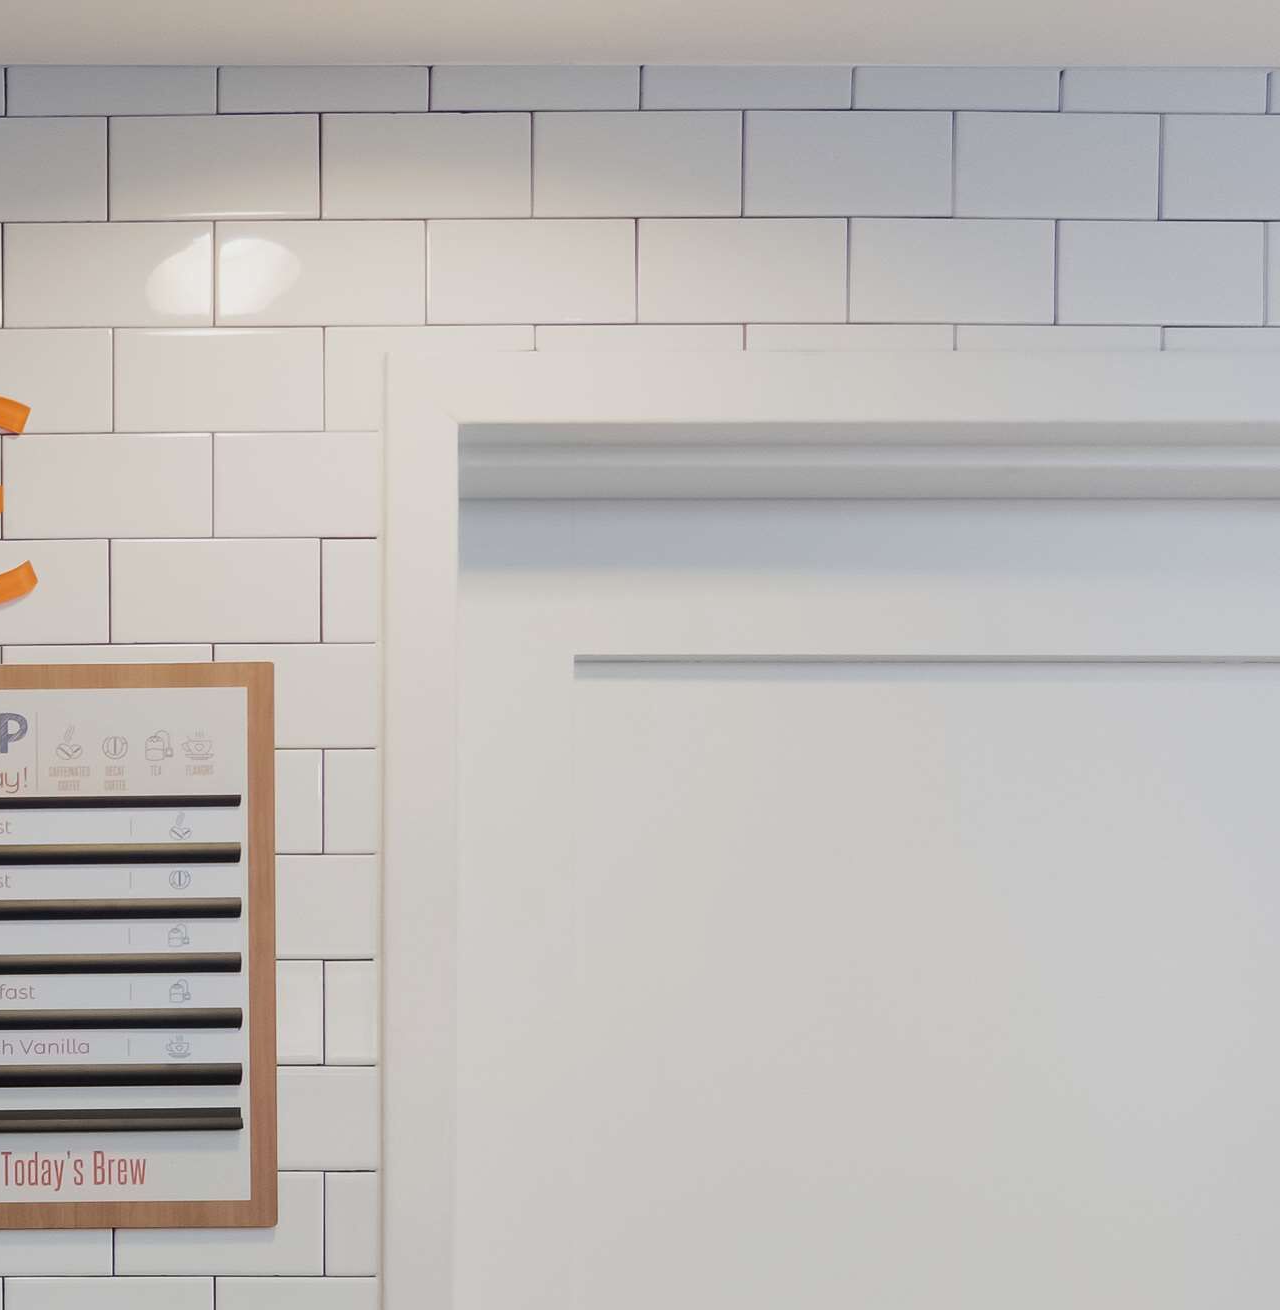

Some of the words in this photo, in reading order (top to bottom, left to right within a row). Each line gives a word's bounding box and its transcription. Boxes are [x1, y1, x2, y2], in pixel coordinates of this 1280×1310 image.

[19, 1038, 90, 1056] Vanilla
[0, 1151, 84, 1191] Today's
[93, 1151, 147, 1185] Brew
